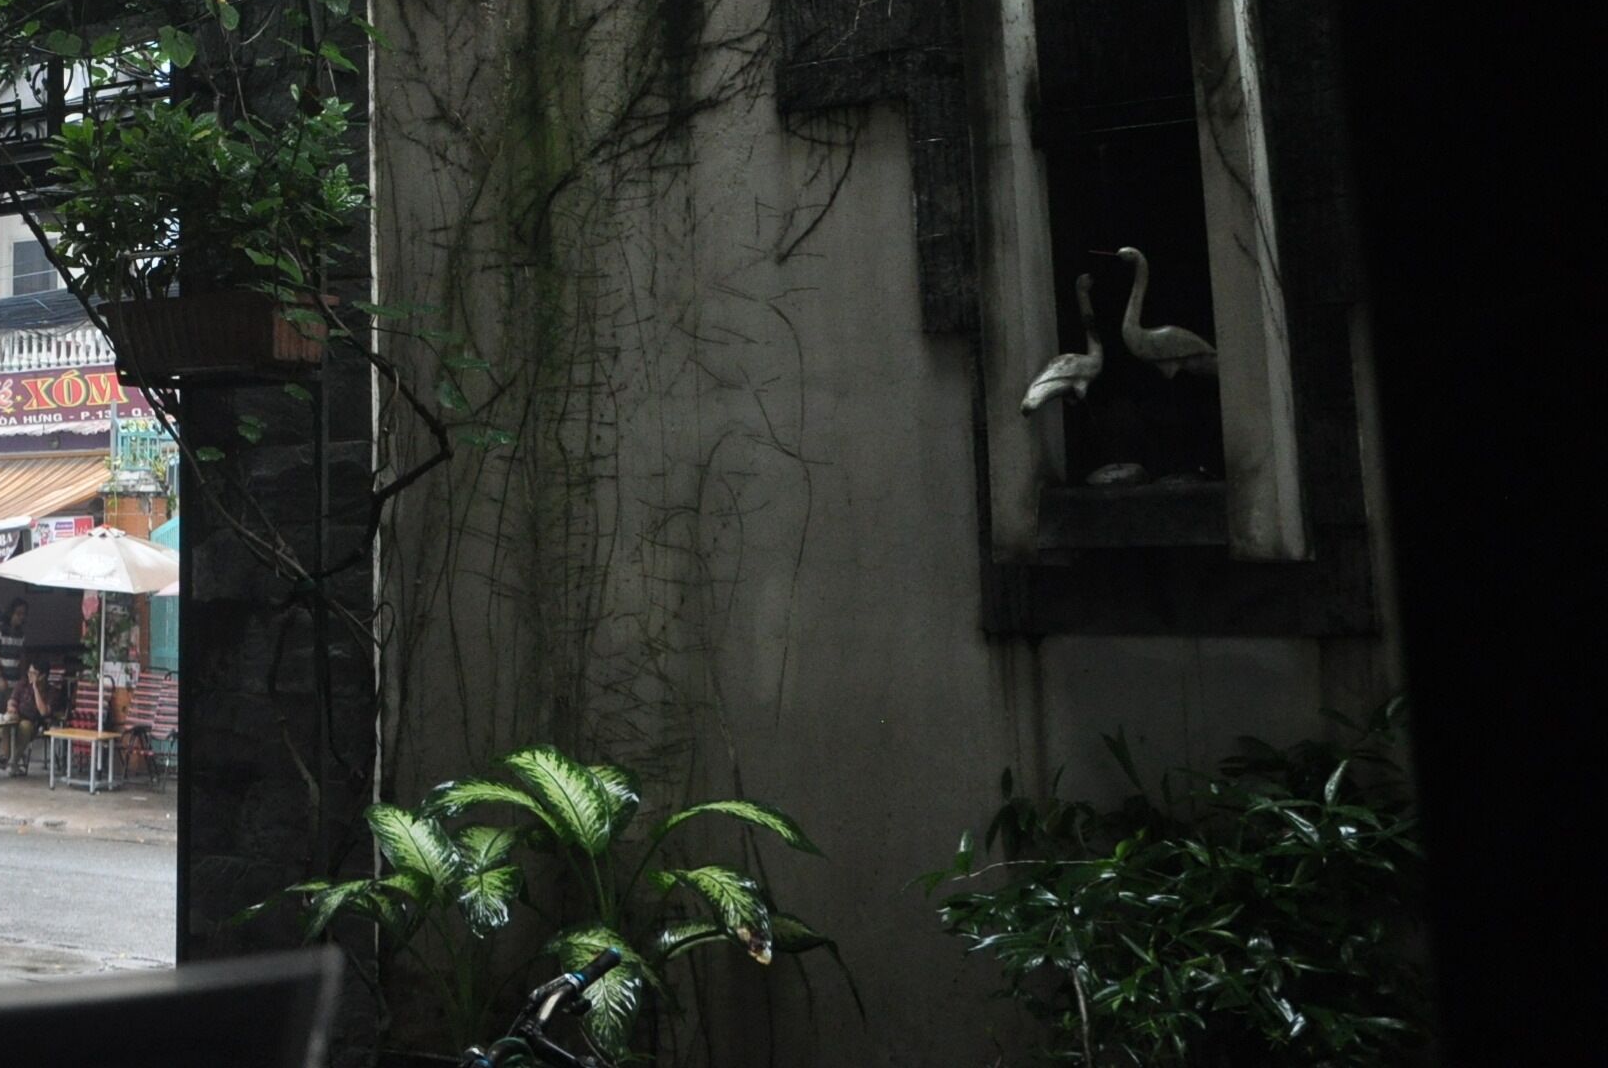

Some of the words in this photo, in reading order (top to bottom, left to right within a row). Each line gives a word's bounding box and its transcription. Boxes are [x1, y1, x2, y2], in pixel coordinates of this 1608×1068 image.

[22, 369, 128, 411] XÓM
[23, 412, 63, 425] HƯNG
[80, 409, 112, 421] P.13
